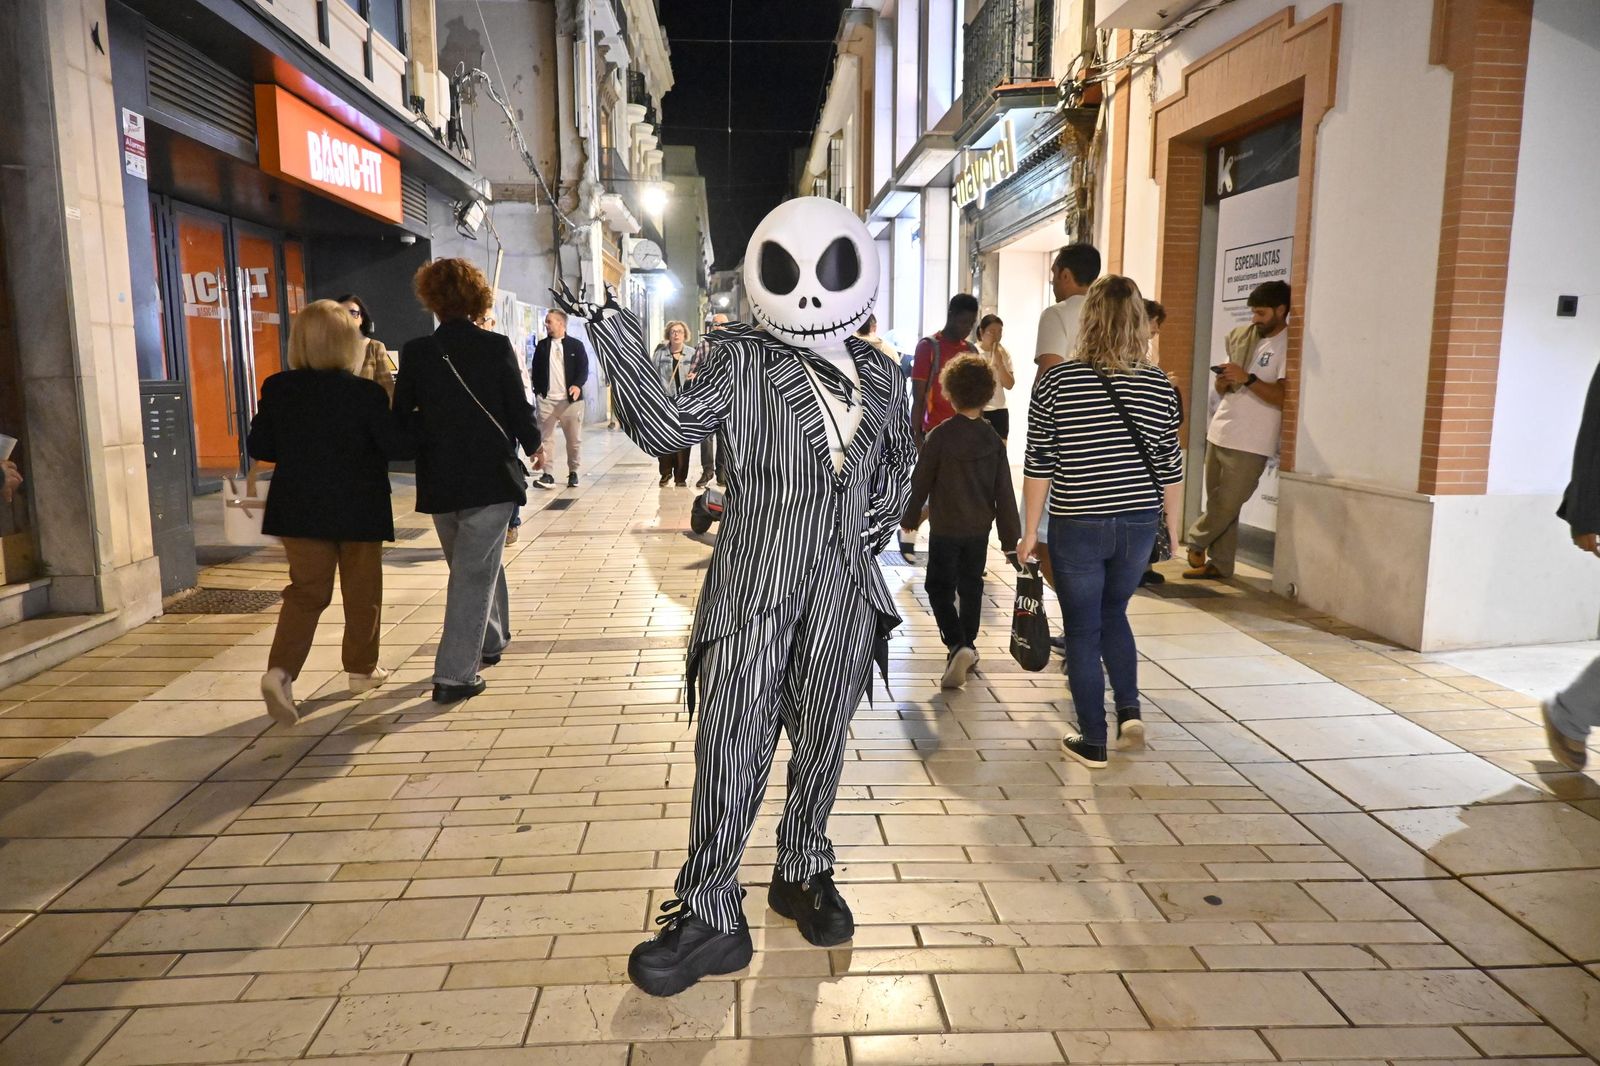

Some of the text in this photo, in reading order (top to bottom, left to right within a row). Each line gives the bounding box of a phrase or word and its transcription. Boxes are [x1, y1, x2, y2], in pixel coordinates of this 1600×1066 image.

[954, 119, 1018, 210] mayoral
[1234, 249, 1280, 271] ESPECIALISTAS
[1233, 272, 1258, 283] soluciones
[1259, 267, 1287, 278] financieras
